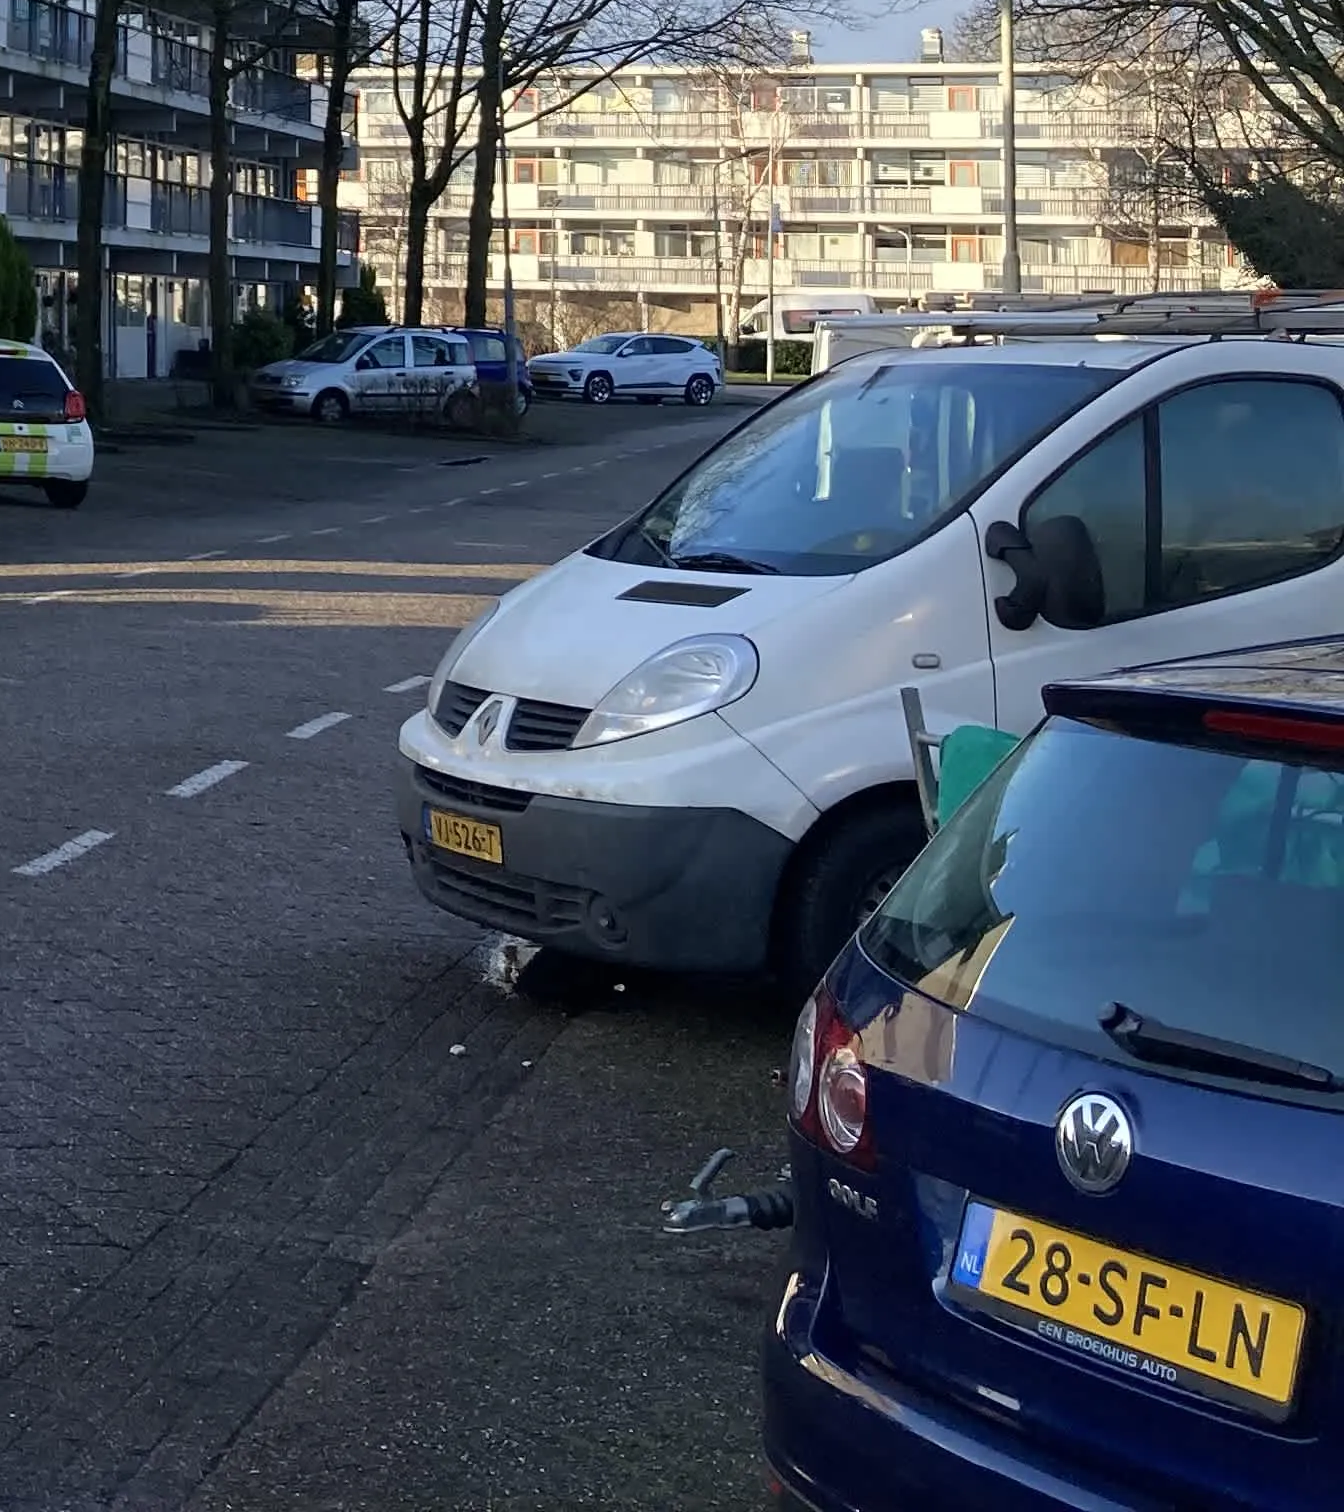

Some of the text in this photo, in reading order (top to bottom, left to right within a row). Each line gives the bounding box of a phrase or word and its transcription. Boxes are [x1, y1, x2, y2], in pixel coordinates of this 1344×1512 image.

[960, 1228, 1271, 1379] NL 28-SF-LN
[1037, 1320, 1177, 1382] EEN BROEKHUIS AUTO
